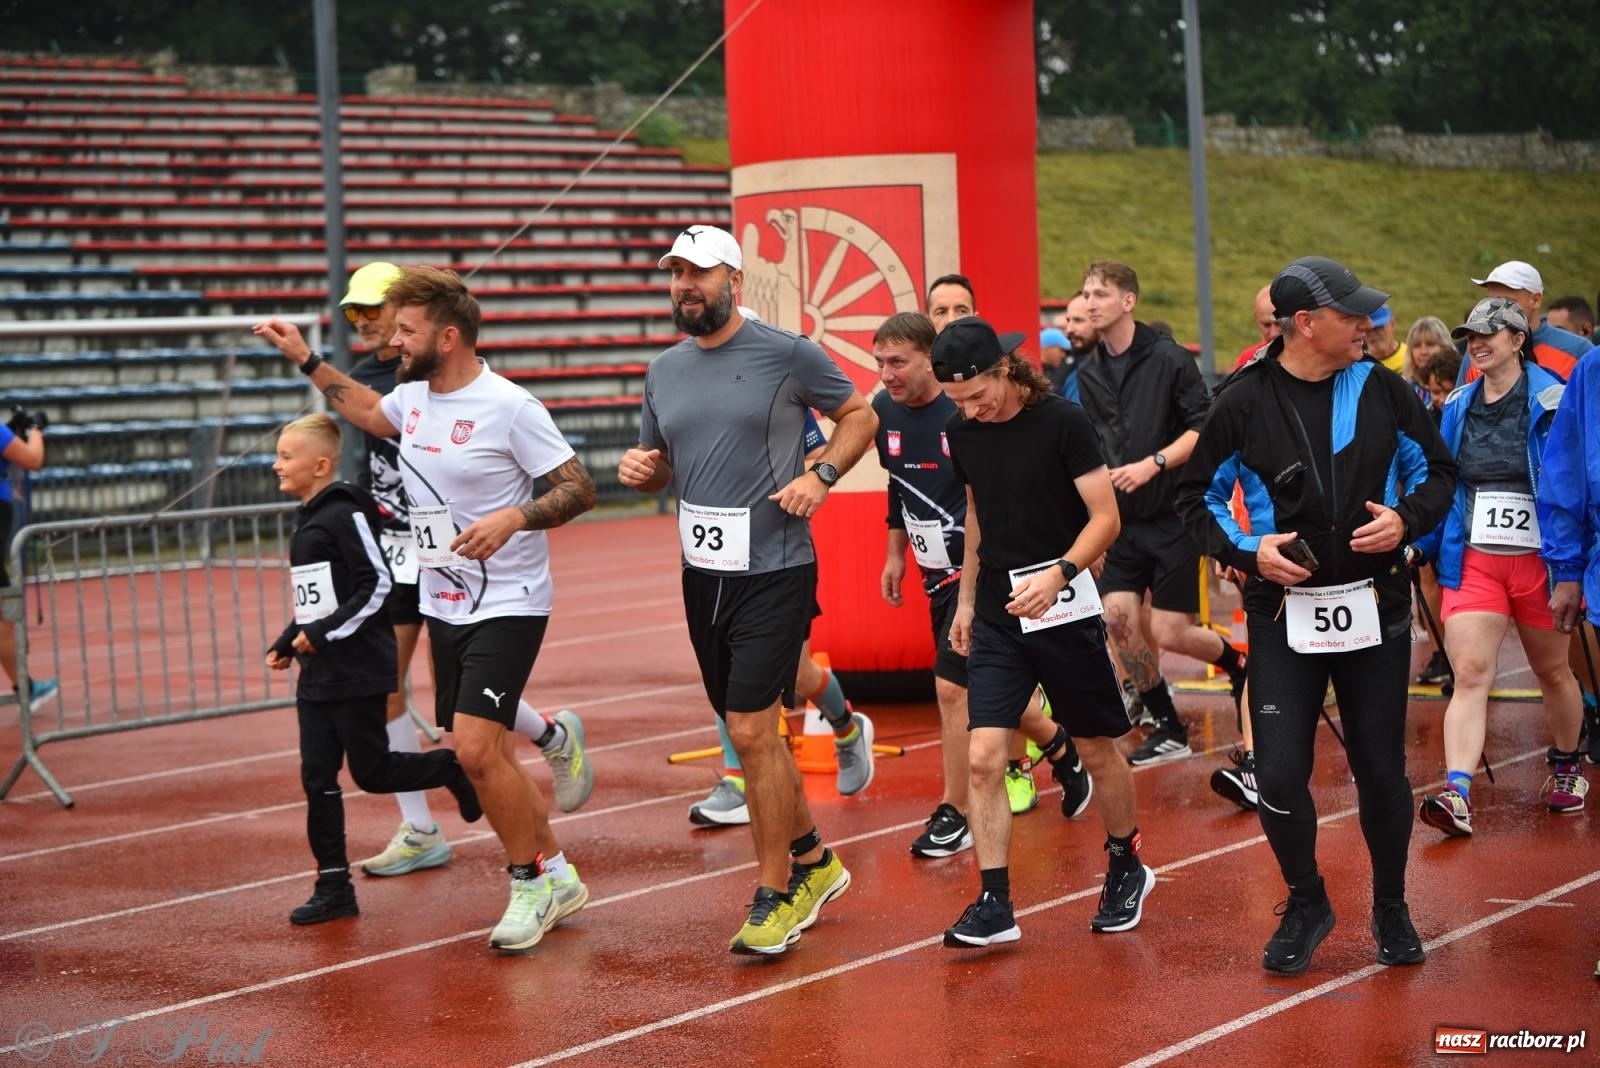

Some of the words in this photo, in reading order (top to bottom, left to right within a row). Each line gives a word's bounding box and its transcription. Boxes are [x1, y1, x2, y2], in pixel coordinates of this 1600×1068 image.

[1486, 508, 1530, 531] 152
[415, 525, 437, 550] 81
[692, 524, 724, 551] 93
[385, 544, 406, 566] 46
[1040, 611, 1073, 624] Racibórz
[1314, 606, 1352, 632] 50
